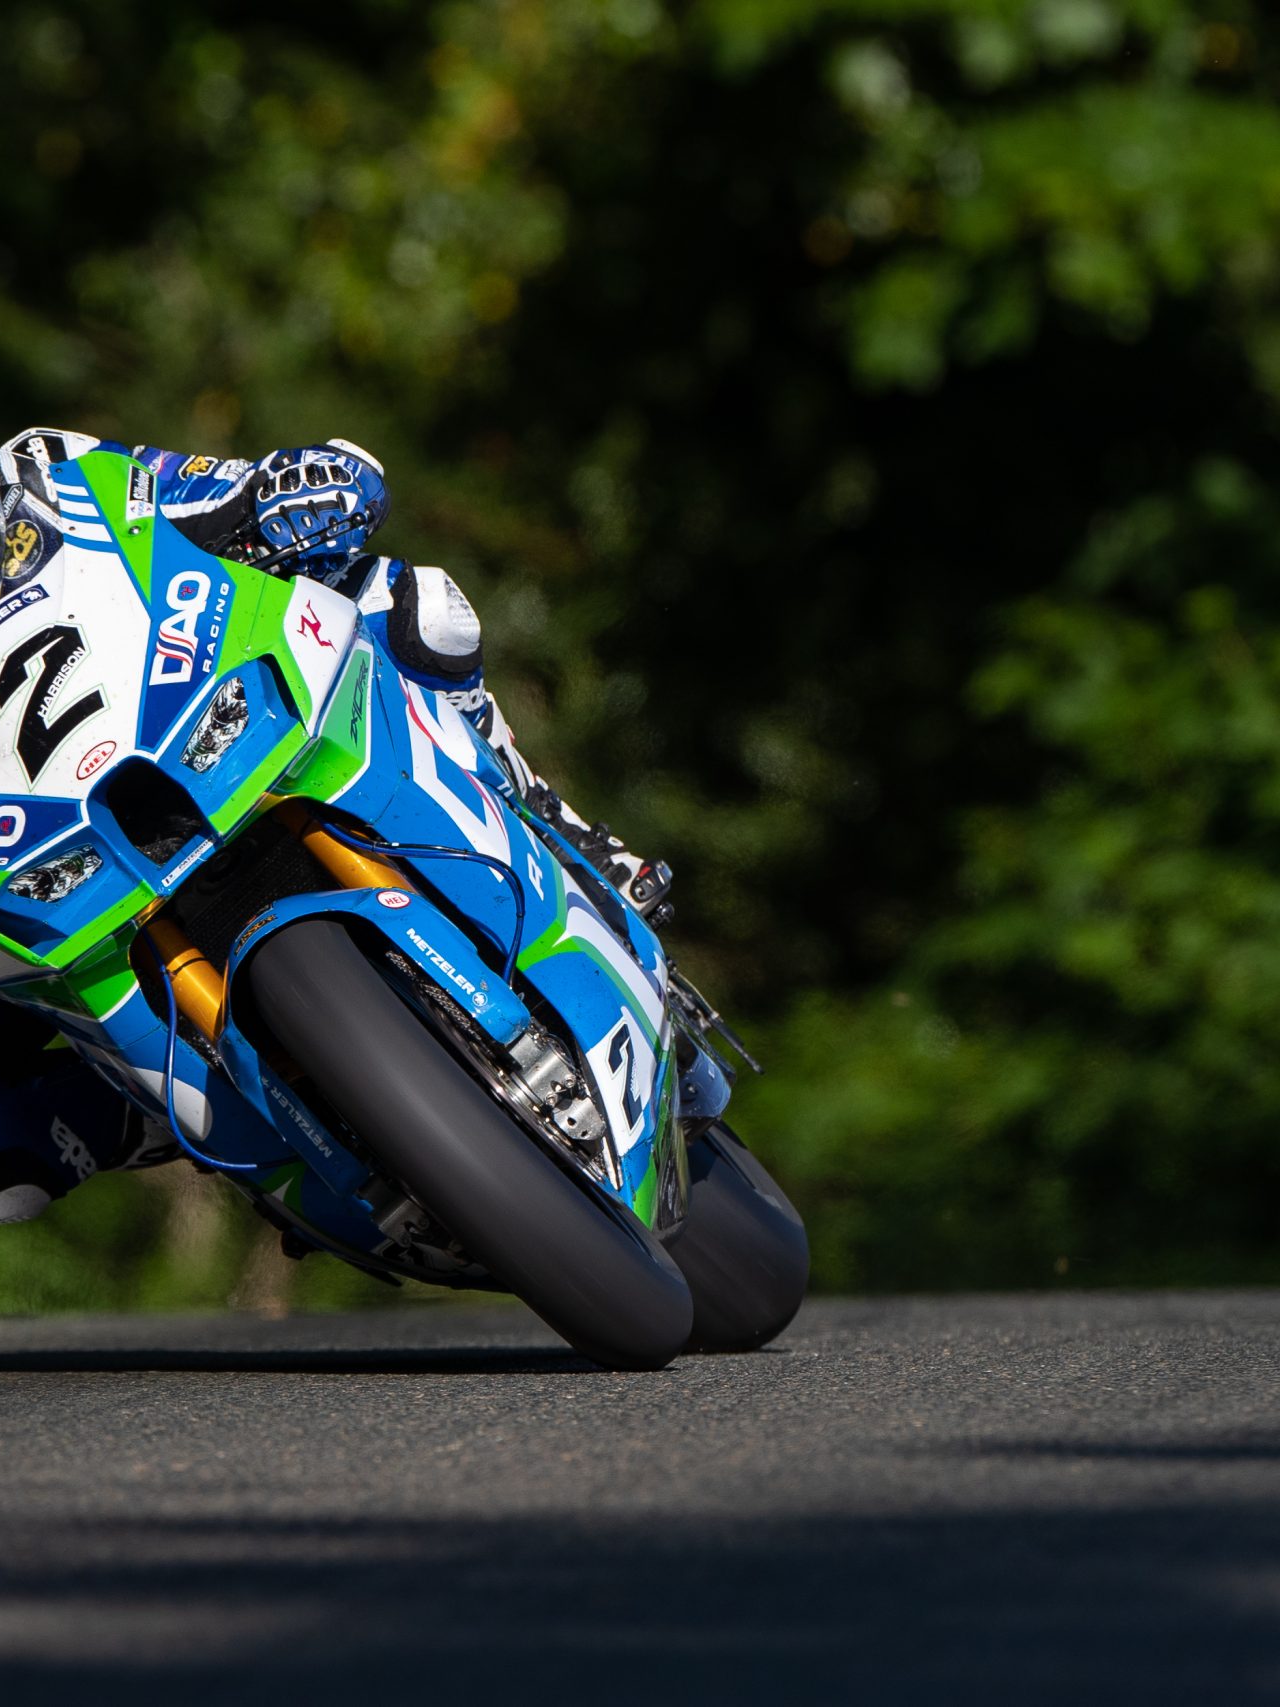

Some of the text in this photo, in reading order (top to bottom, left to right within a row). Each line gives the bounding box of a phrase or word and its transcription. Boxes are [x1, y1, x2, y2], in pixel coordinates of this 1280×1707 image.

[148, 570, 212, 686] DAO
[202, 582, 230, 673] RACING
[84, 750, 111, 773] HEL
[384, 896, 407, 905] HEL
[406, 928, 470, 995] METZELER
[608, 1023, 644, 1131] 2
[270, 1086, 333, 1158] METZELER
